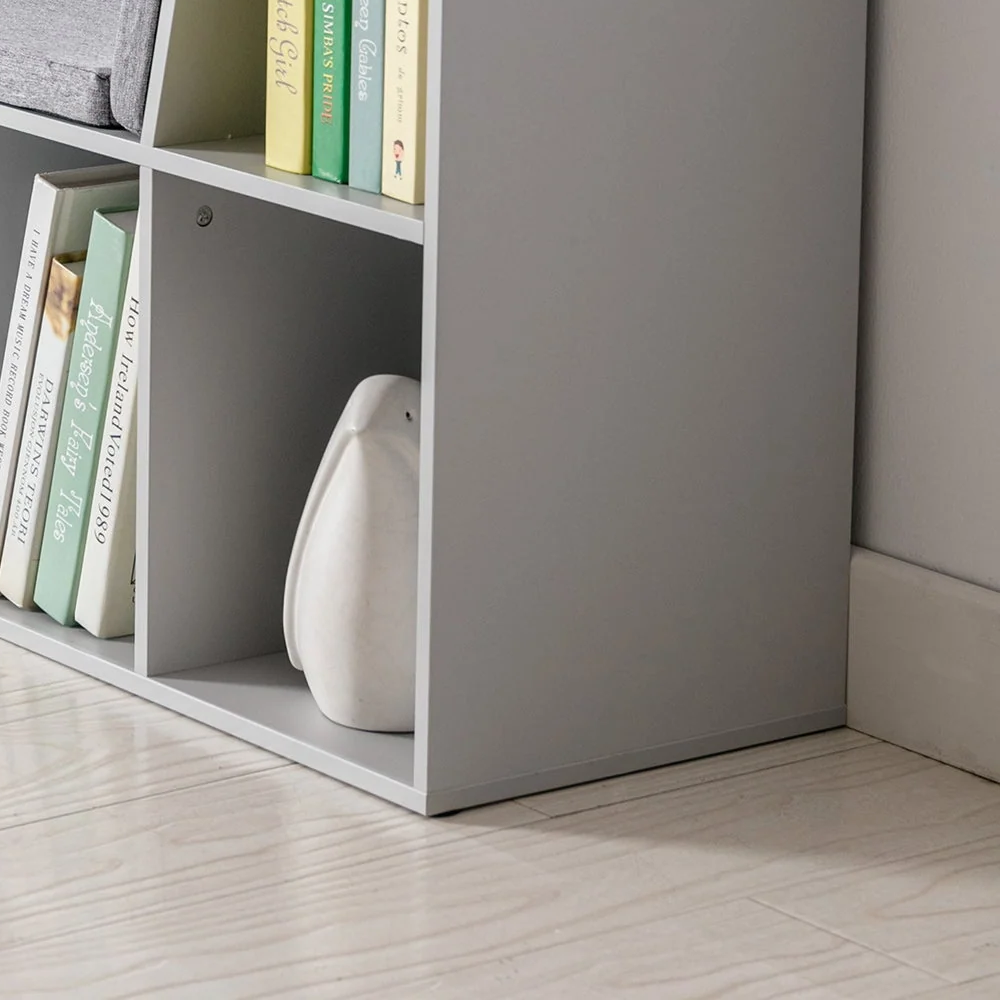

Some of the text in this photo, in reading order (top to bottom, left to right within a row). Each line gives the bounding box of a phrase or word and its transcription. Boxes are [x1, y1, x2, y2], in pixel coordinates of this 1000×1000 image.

[322, 2, 335, 69] SIMBA'S
[269, 36, 299, 95] Girl
[358, 38, 378, 101] Gables
[321, 73, 334, 126] PRIDE
[25, 272, 33, 281] A
[28, 239, 40, 270] HAVE
[19, 284, 32, 321] DREAM
[125, 296, 140, 348] How
[12, 323, 25, 361] MUSIC
[5, 362, 19, 407] RECORD
[0, 409, 11, 438] BOOK
[53, 297, 113, 543] Andersen's Fairy Tales
[17, 378, 54, 544] DARWINS TEORI
